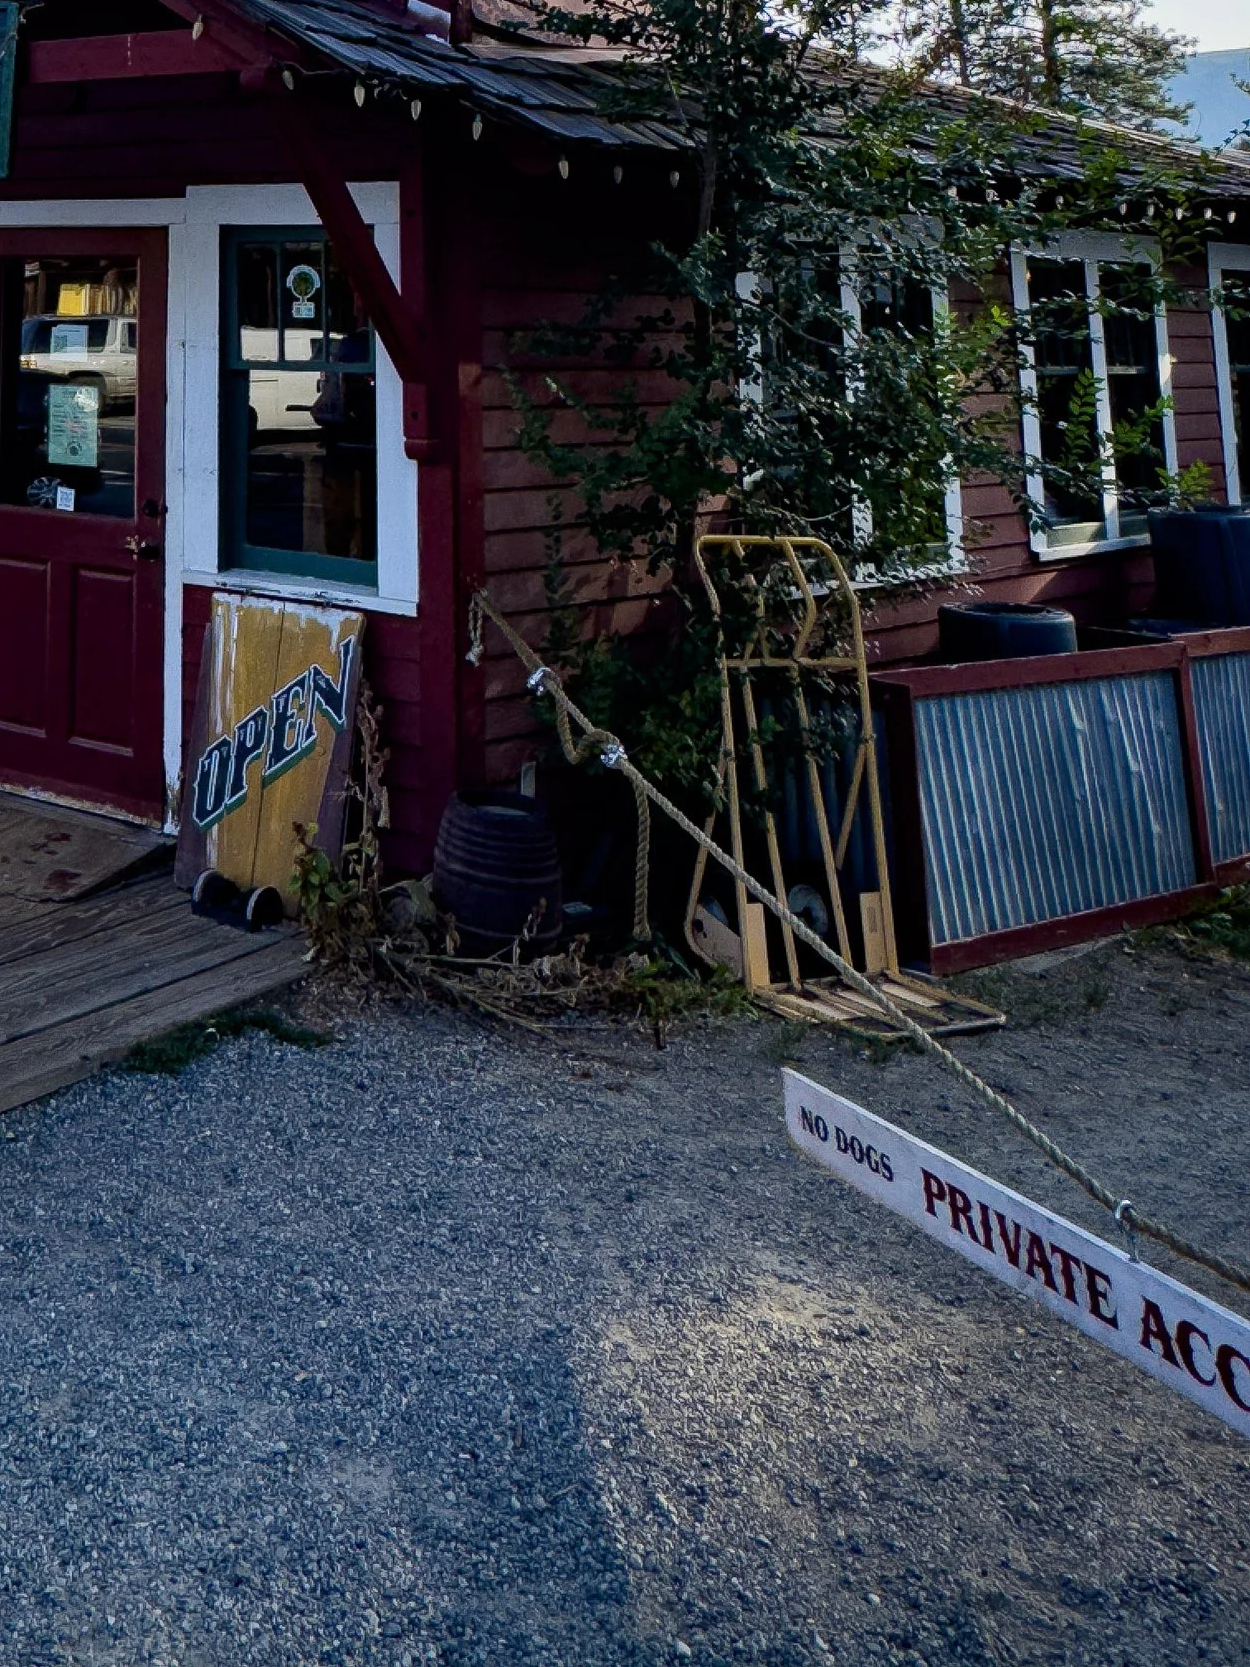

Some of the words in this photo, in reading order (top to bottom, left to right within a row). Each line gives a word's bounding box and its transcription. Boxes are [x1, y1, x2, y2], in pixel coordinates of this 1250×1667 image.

[193, 635, 355, 829] OPEN
[800, 1105, 829, 1142] NO
[834, 1126, 894, 1183] DOGS
[920, 1166, 1120, 1331] PRIVATE
